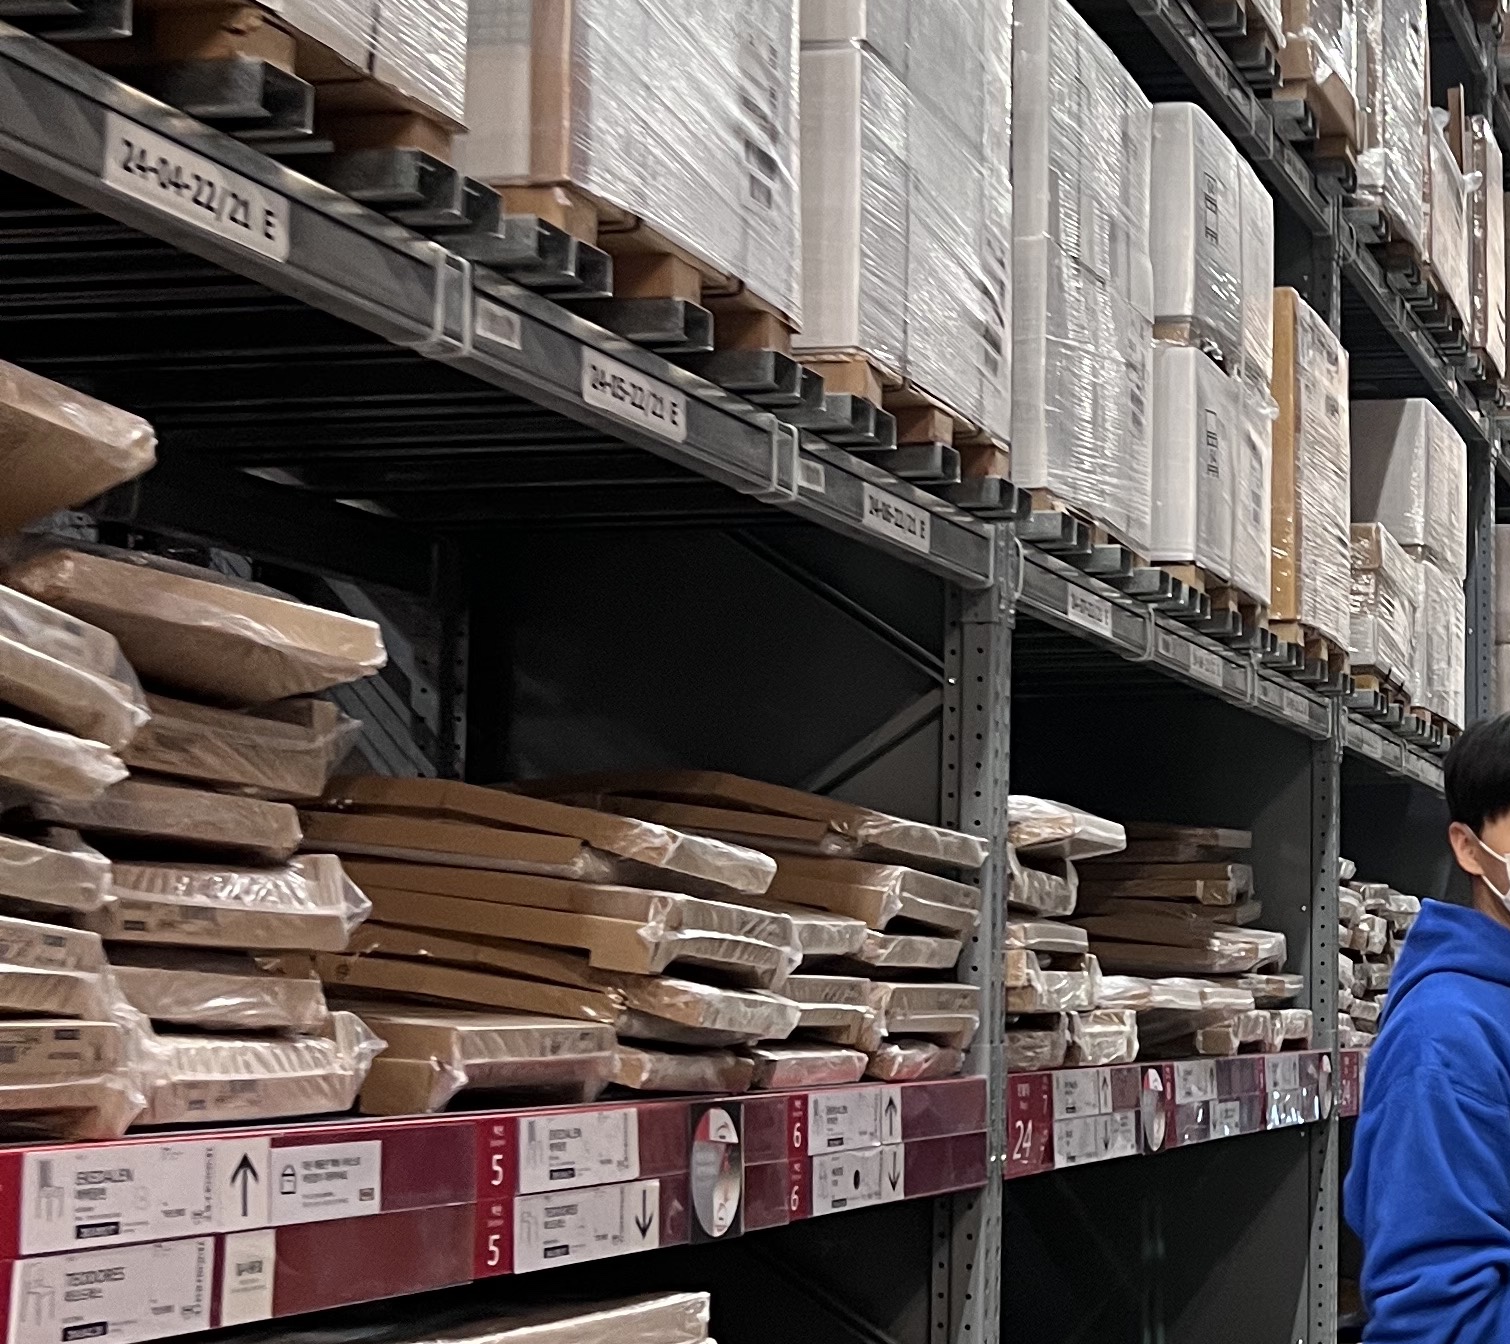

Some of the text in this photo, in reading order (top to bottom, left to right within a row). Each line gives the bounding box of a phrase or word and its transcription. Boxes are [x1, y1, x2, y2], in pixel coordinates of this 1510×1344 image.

[122, 137, 276, 242] 24-04-22/21 E
[669, 400, 679, 427] E
[793, 1122, 802, 1148] 6
[1012, 1119, 1033, 1161] 24
[490, 1153, 504, 1187] 5
[790, 1185, 800, 1211] 6
[486, 1234, 500, 1266] 5
